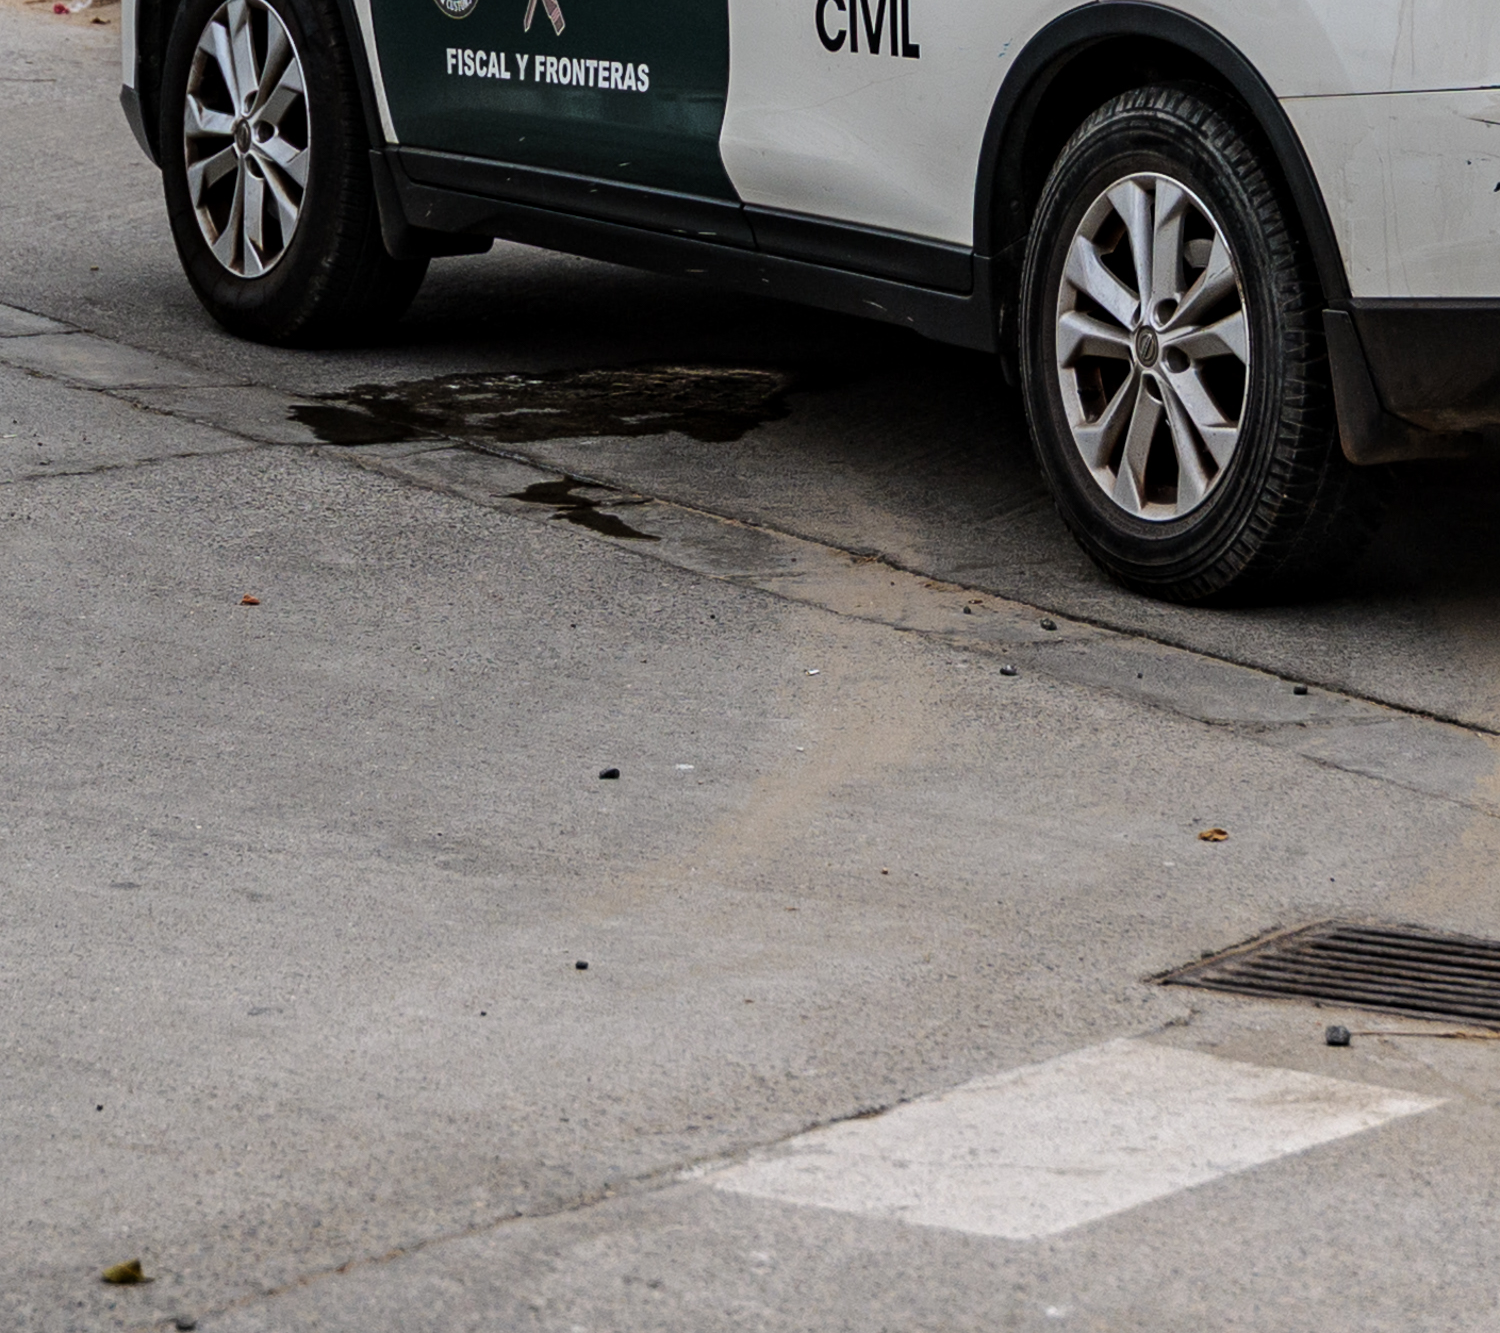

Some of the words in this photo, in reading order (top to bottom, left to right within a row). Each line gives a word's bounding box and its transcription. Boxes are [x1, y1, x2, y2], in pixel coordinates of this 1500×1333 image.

[446, 47, 511, 79] FISCAL
[516, 53, 529, 81] Y
[534, 55, 650, 92] FRONTERAS
